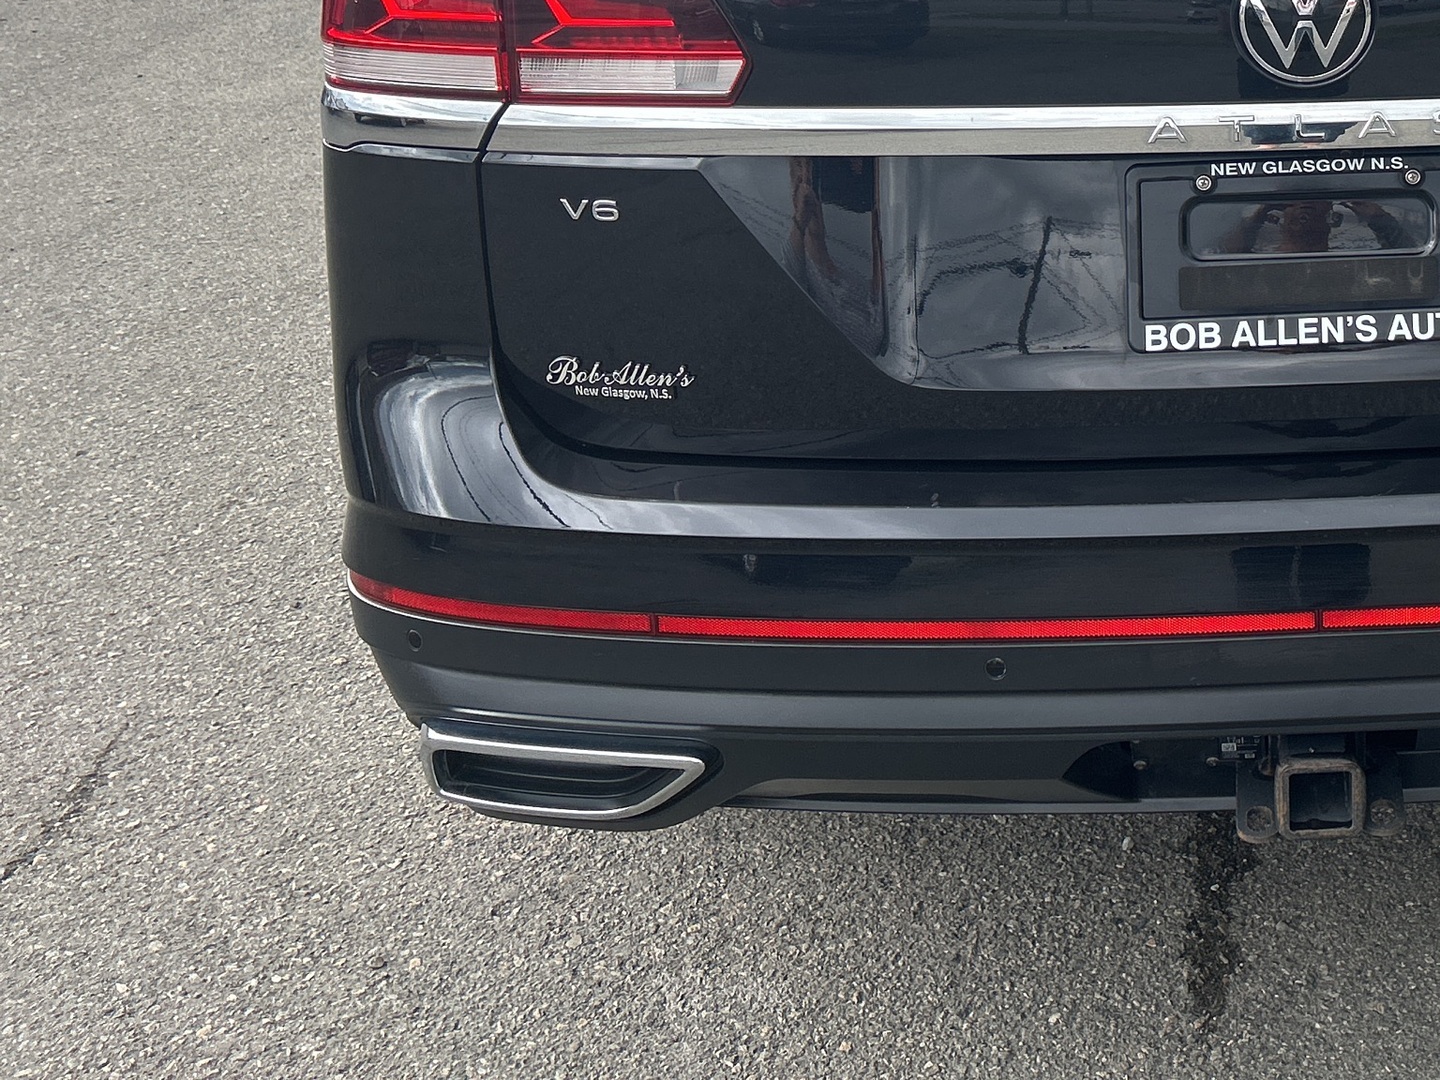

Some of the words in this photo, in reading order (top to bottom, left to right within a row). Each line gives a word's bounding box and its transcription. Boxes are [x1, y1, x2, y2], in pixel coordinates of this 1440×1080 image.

[1211, 162, 1256, 176] NEW
[1262, 158, 1365, 174] GLASGOW
[1371, 156, 1409, 171] N.S.
[559, 198, 620, 221] V6
[1144, 322, 1222, 352] BOB
[1232, 314, 1378, 348] ALLEN'S
[546, 355, 604, 386] Bob
[604, 361, 695, 388] Allen's
[575, 385, 599, 397] New
[601, 386, 648, 400] Glasgow,
[650, 388, 672, 399] N.S.
